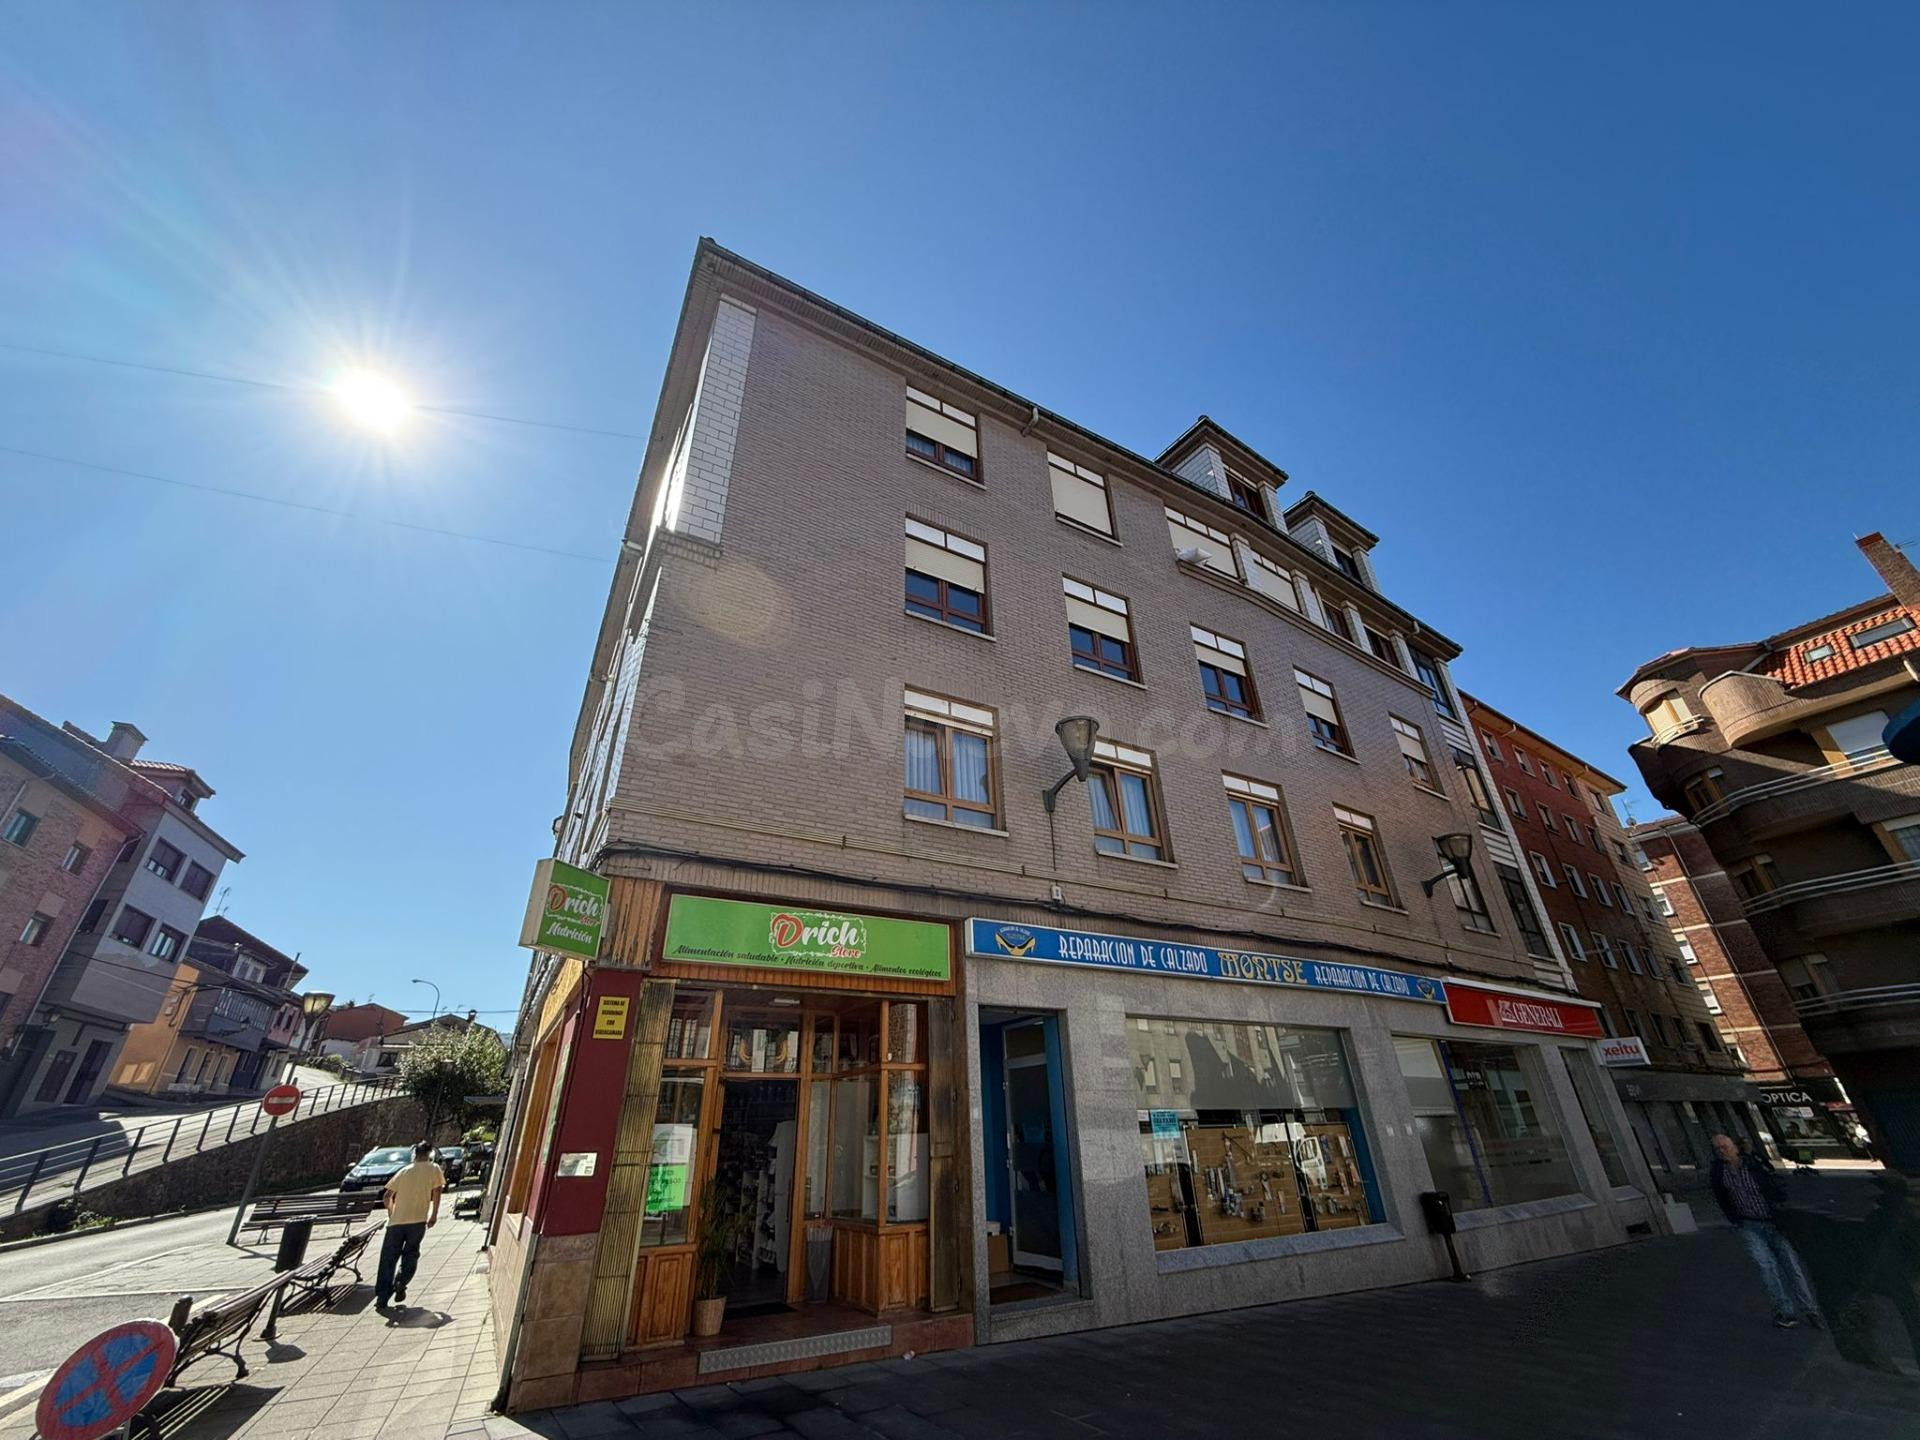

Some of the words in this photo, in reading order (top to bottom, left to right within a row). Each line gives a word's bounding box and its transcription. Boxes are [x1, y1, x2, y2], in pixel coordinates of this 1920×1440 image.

[548, 885, 600, 917] Drich
[546, 922, 592, 943] Nutrición
[770, 912, 860, 949] Drich
[672, 945, 735, 959] Alimentación
[737, 952, 778, 962] saludable
[784, 955, 825, 967] Nutrición
[827, 960, 864, 971] deportiva
[869, 963, 907, 975] Alimentos
[908, 966, 942, 978] ecológicos
[831, 944, 861, 958] Store
[1058, 935, 1136, 966] REPARACION
[1140, 945, 1156, 967] DE
[1161, 948, 1208, 973] CALZADO
[1217, 952, 1308, 984] MONTSE
[1313, 965, 1368, 989] REPARACION
[1367, 972, 1381, 991] DE
[1380, 974, 1410, 995] CALZADO
[1513, 1003, 1564, 1028] GENERALI
[1603, 1040, 1640, 1058] xeitu
